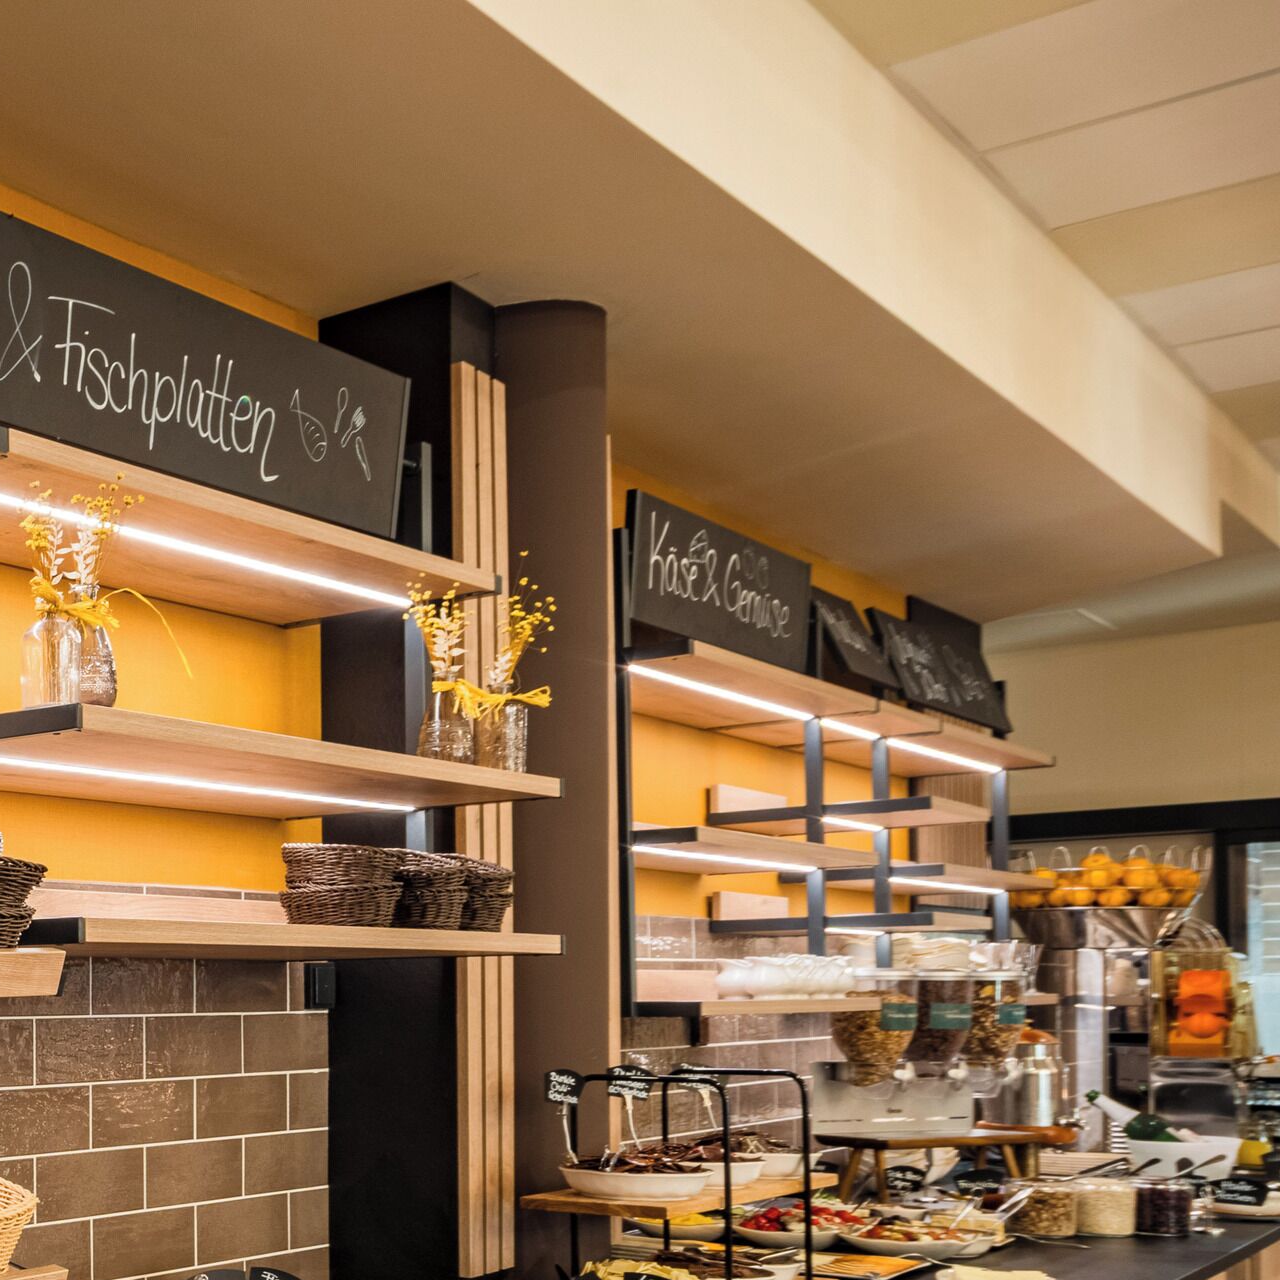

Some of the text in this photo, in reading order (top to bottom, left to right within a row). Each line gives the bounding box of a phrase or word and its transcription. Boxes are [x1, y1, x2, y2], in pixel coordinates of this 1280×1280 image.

[48, 295, 279, 481] Fischplatten
[648, 511, 700, 601] Käse
[702, 549, 720, 606] &
[724, 553, 792, 638] Gemüse
